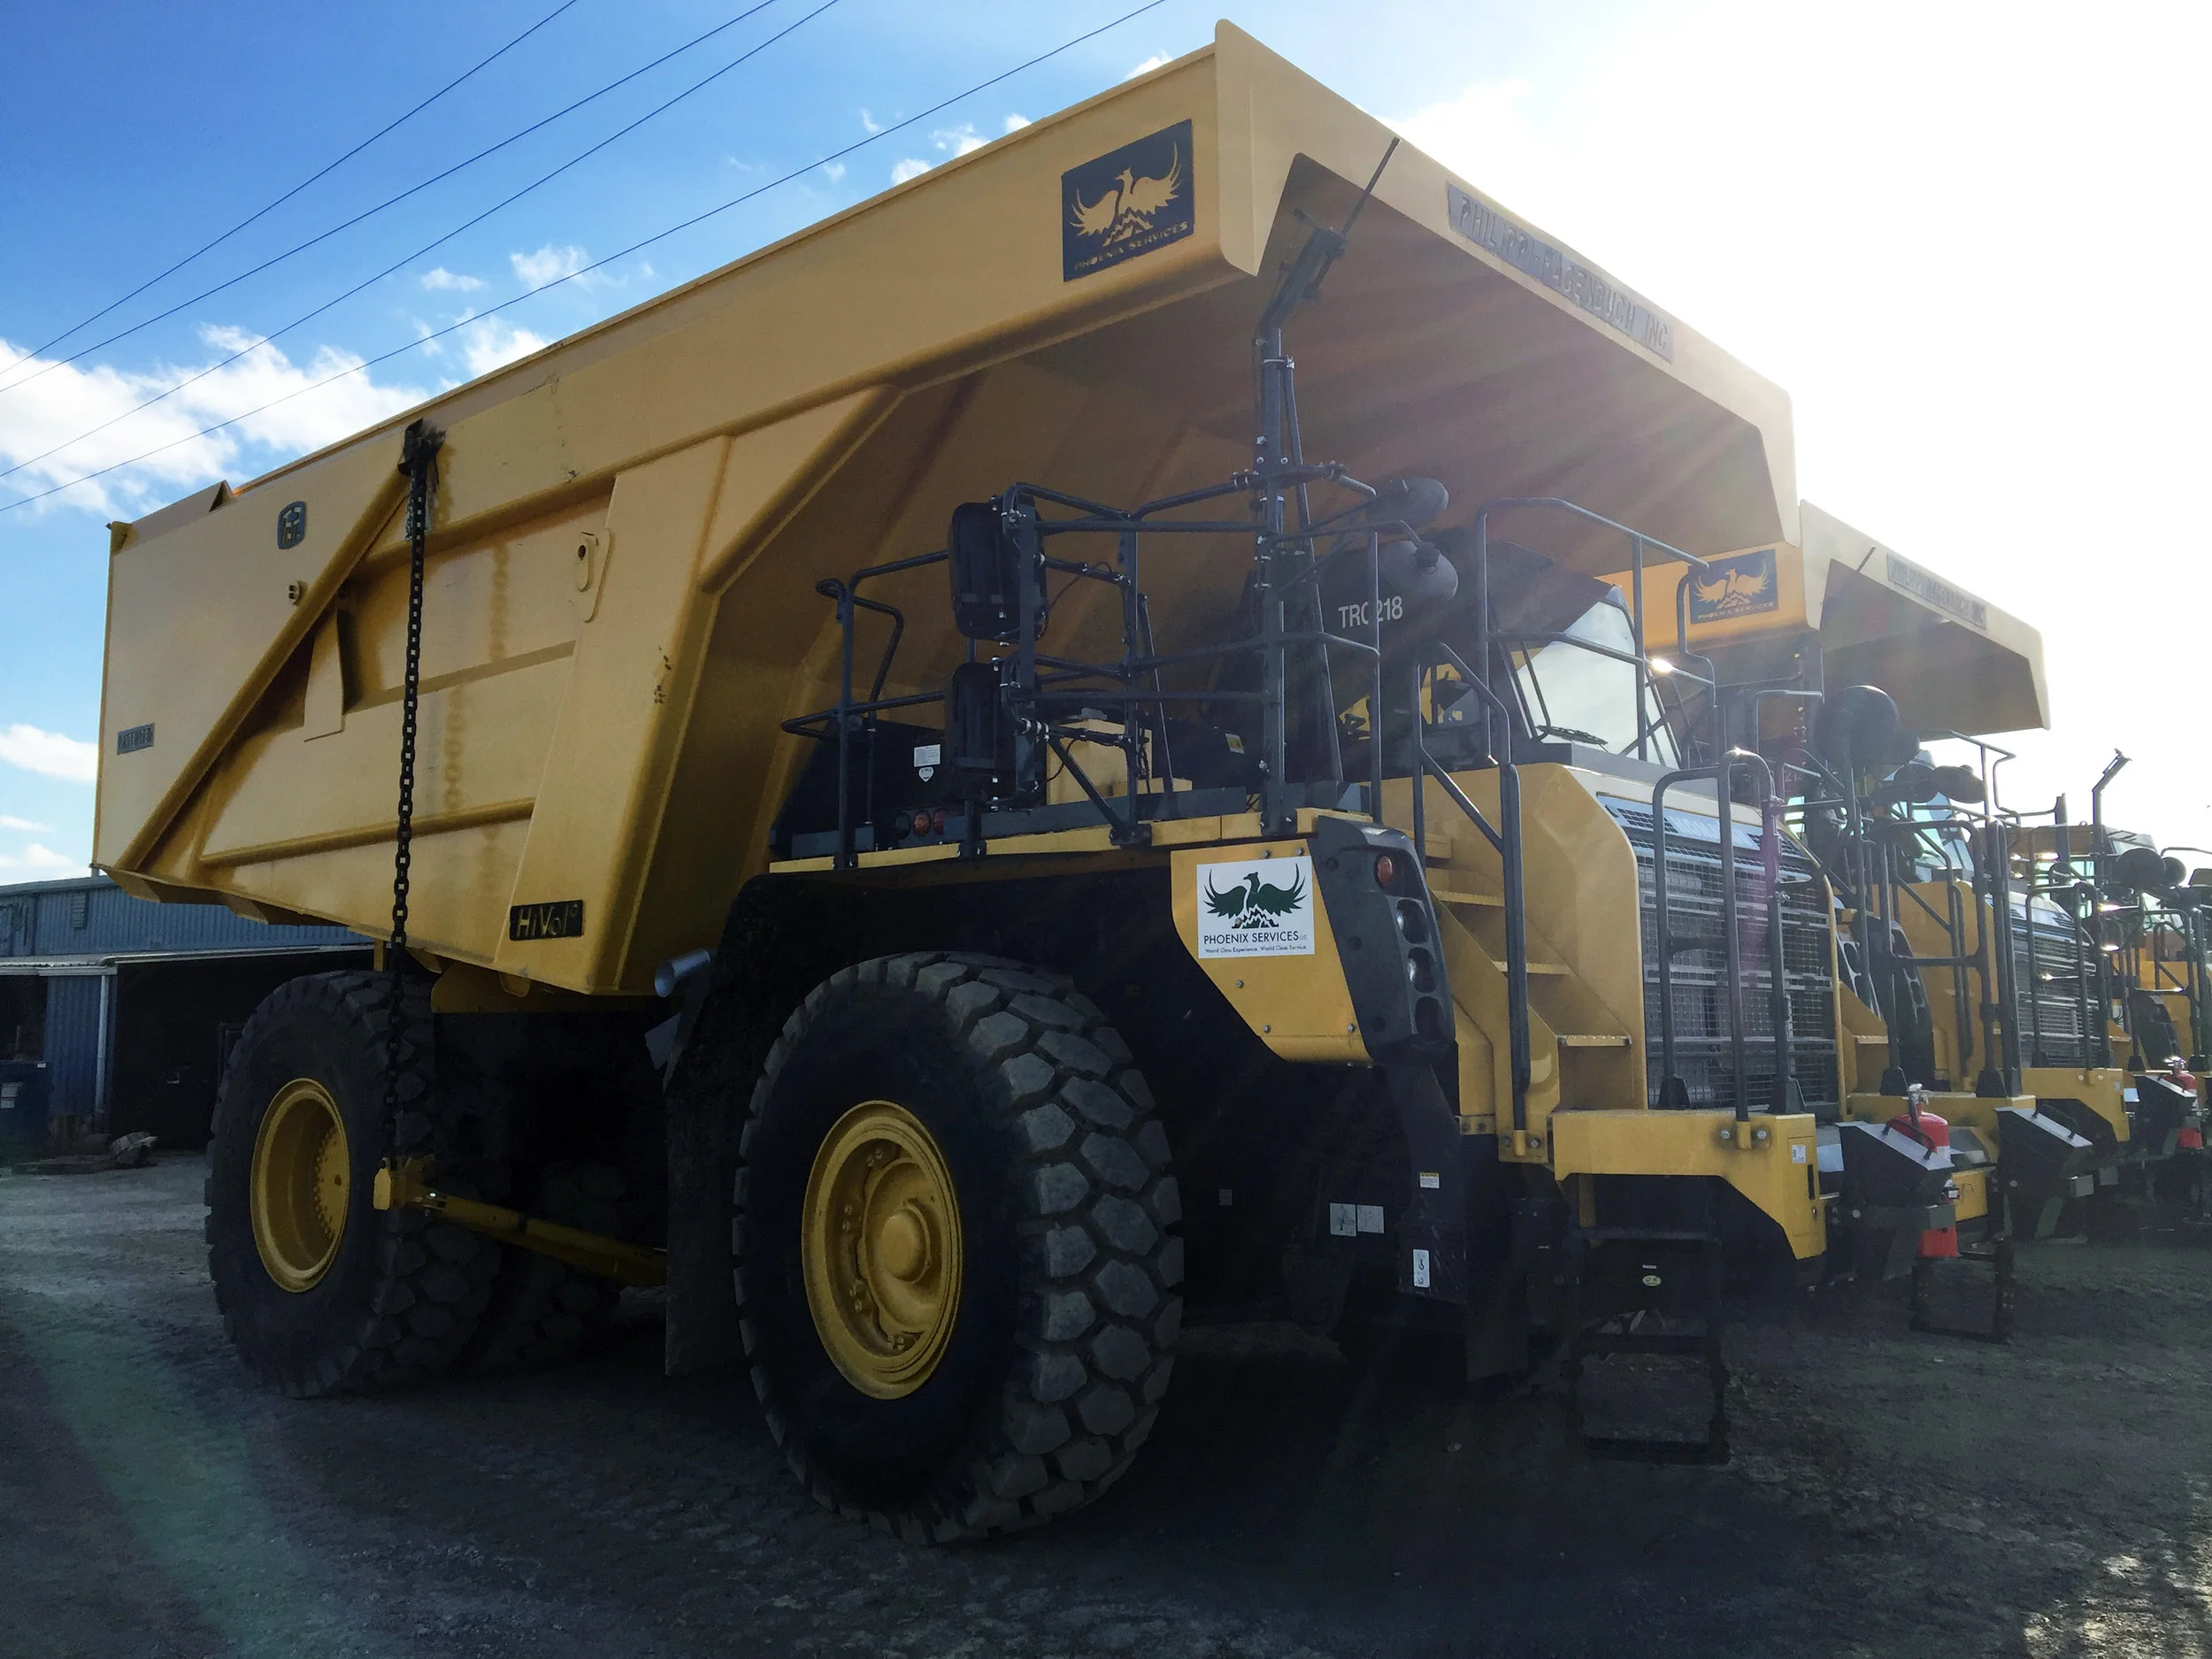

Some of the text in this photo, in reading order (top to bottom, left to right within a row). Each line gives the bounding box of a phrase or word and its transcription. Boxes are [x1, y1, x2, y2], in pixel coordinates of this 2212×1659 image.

[1128, 221, 1187, 250] SERVICES
[1643, 313, 1668, 350] INC
[1338, 595, 1403, 628] TRC 218
[1203, 933, 1248, 945] PHOENIX
[1251, 930, 1299, 942] SERVICES
